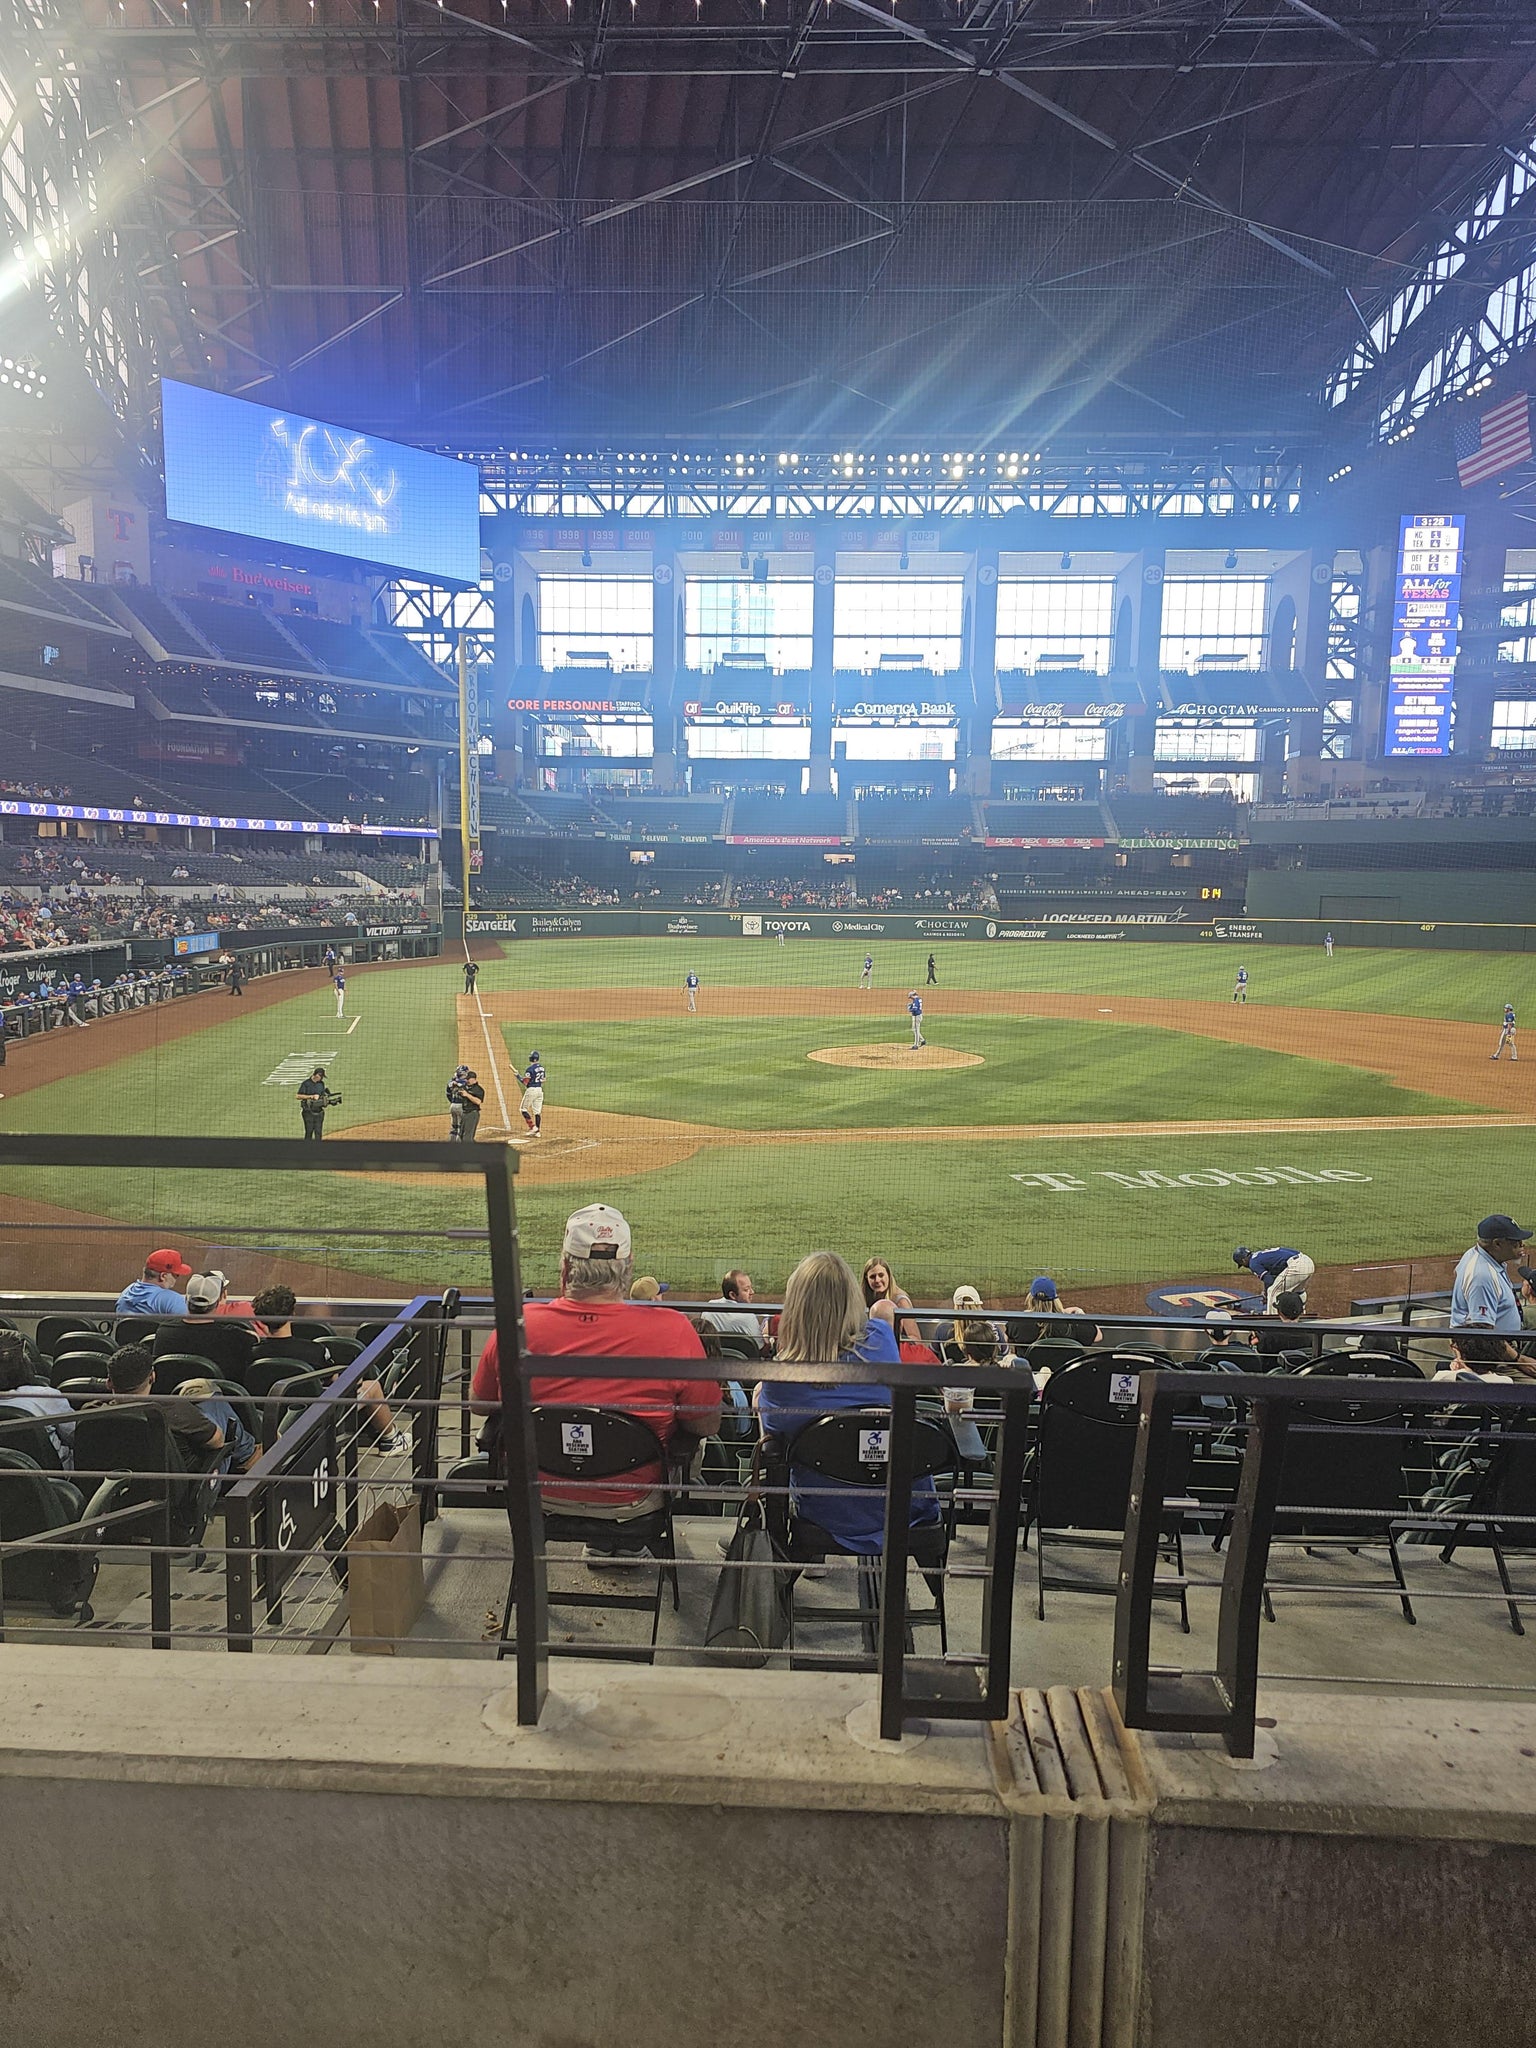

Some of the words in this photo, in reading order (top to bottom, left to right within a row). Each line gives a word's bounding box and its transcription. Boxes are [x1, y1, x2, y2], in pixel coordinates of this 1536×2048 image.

[106, 507, 135, 542] T
[558, 530, 579, 539] 1998
[593, 530, 614, 539] 1999
[628, 530, 650, 540] 2010
[719, 531, 738, 541] 2011
[753, 531, 772, 541] 2011
[789, 531, 810, 541] 2012
[912, 532, 935, 541] 2023
[496, 566, 511, 578] 42
[656, 568, 671, 580] 34
[817, 569, 832, 581] 26
[984, 569, 992, 580] 7
[1146, 569, 1161, 580] 29
[1316, 568, 1328, 580] 10
[1403, 579, 1434, 589] ALL
[1428, 578, 1452, 594] for
[1402, 589, 1449, 599] TEXAS
[508, 699, 539, 710] CORE
[543, 700, 613, 711] PERSONNEL
[686, 703, 699, 714] QT
[716, 702, 761, 716] QuikTrip
[778, 703, 792, 714] QT
[920, 703, 956, 715] Bank
[1185, 703, 1258, 715] CHOCTAW
[469, 757, 478, 834] CHIKIN
[641, 835, 668, 843] 7-ELEVEN
[680, 835, 707, 843] 7-ELEVEN
[1132, 839, 1173, 848] LUXOR
[1175, 839, 1237, 849] STAFFING
[1043, 914, 1111, 923] LOCKHEED
[1115, 914, 1167, 923] MARTIN
[466, 919, 516, 932] SEATGEEK
[765, 921, 811, 931] TOYOTA
[920, 920, 969, 929] CHOCTAW
[366, 926, 398, 936] VICTORY
[999, 930, 1049, 938] PROGRESSIVE
[1009, 1173, 1087, 1191] T
[1090, 1166, 1373, 1188] Mobile
[1479, 1306, 1487, 1316] T
[312, 1457, 328, 1508] 16
